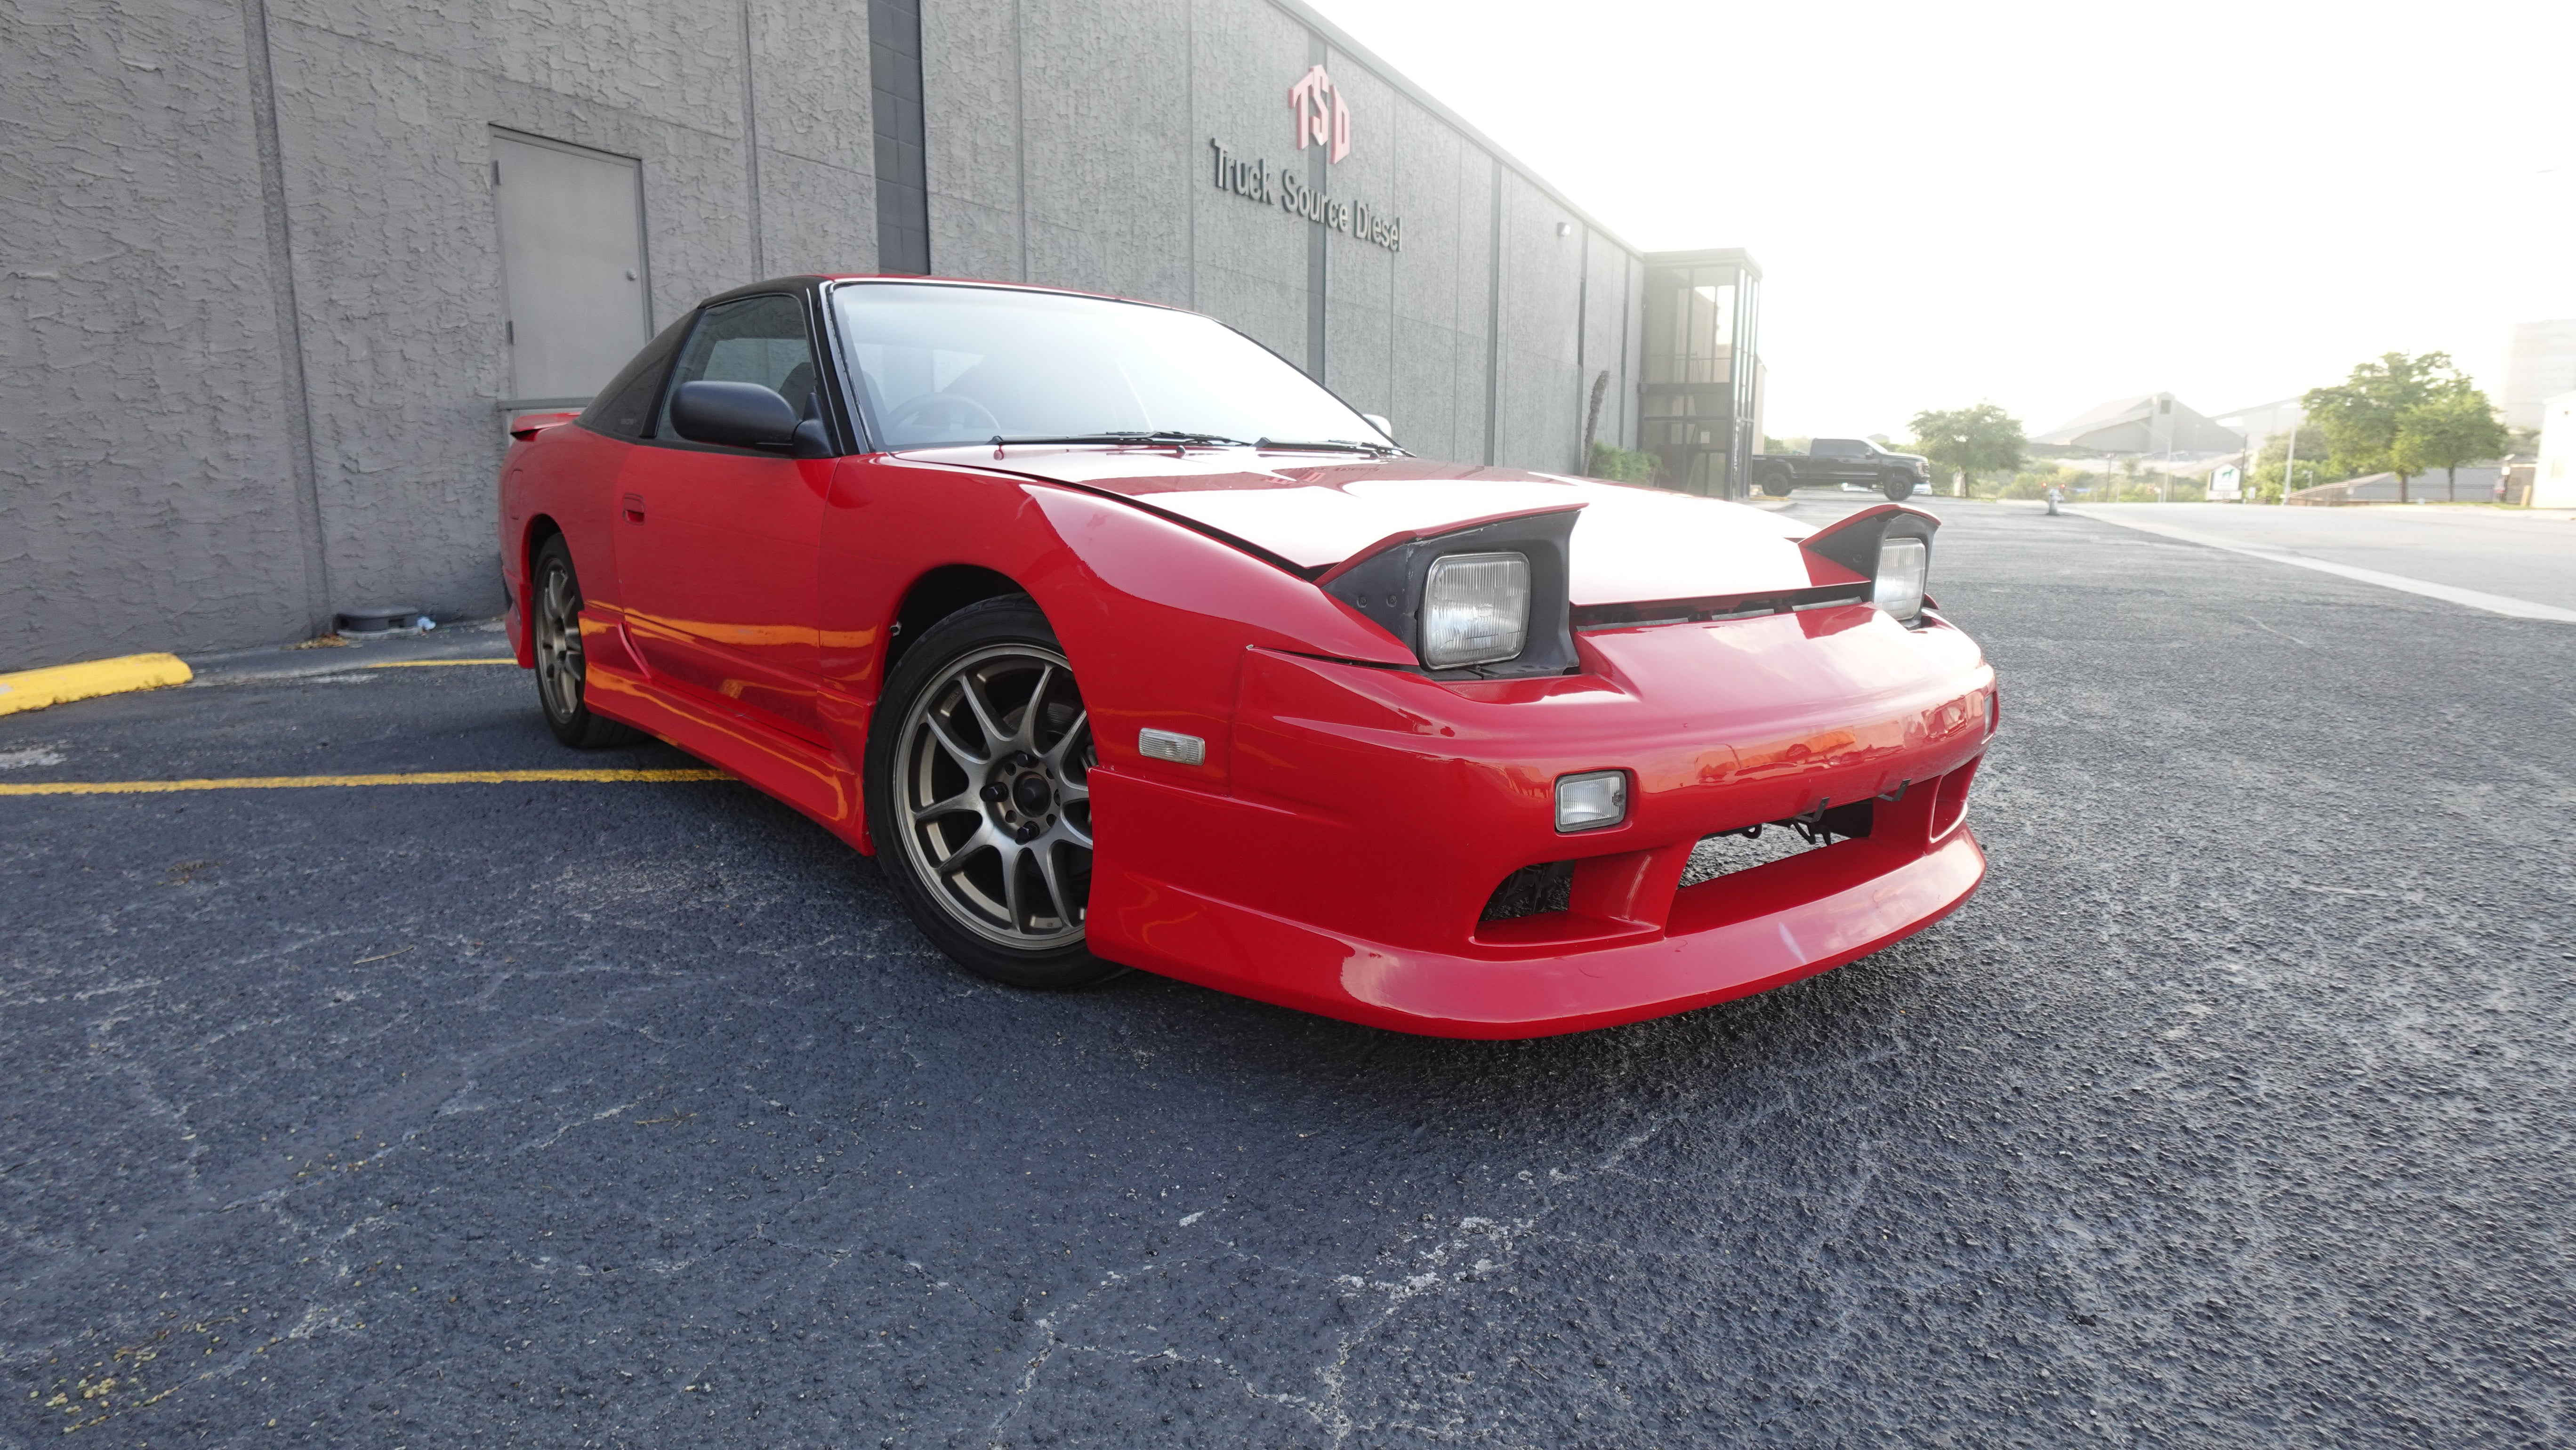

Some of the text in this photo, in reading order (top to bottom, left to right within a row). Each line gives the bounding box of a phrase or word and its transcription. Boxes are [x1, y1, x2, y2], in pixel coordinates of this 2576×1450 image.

[1289, 64, 1350, 164] TSD
[1210, 137, 1402, 252] Truck Source Diesel
